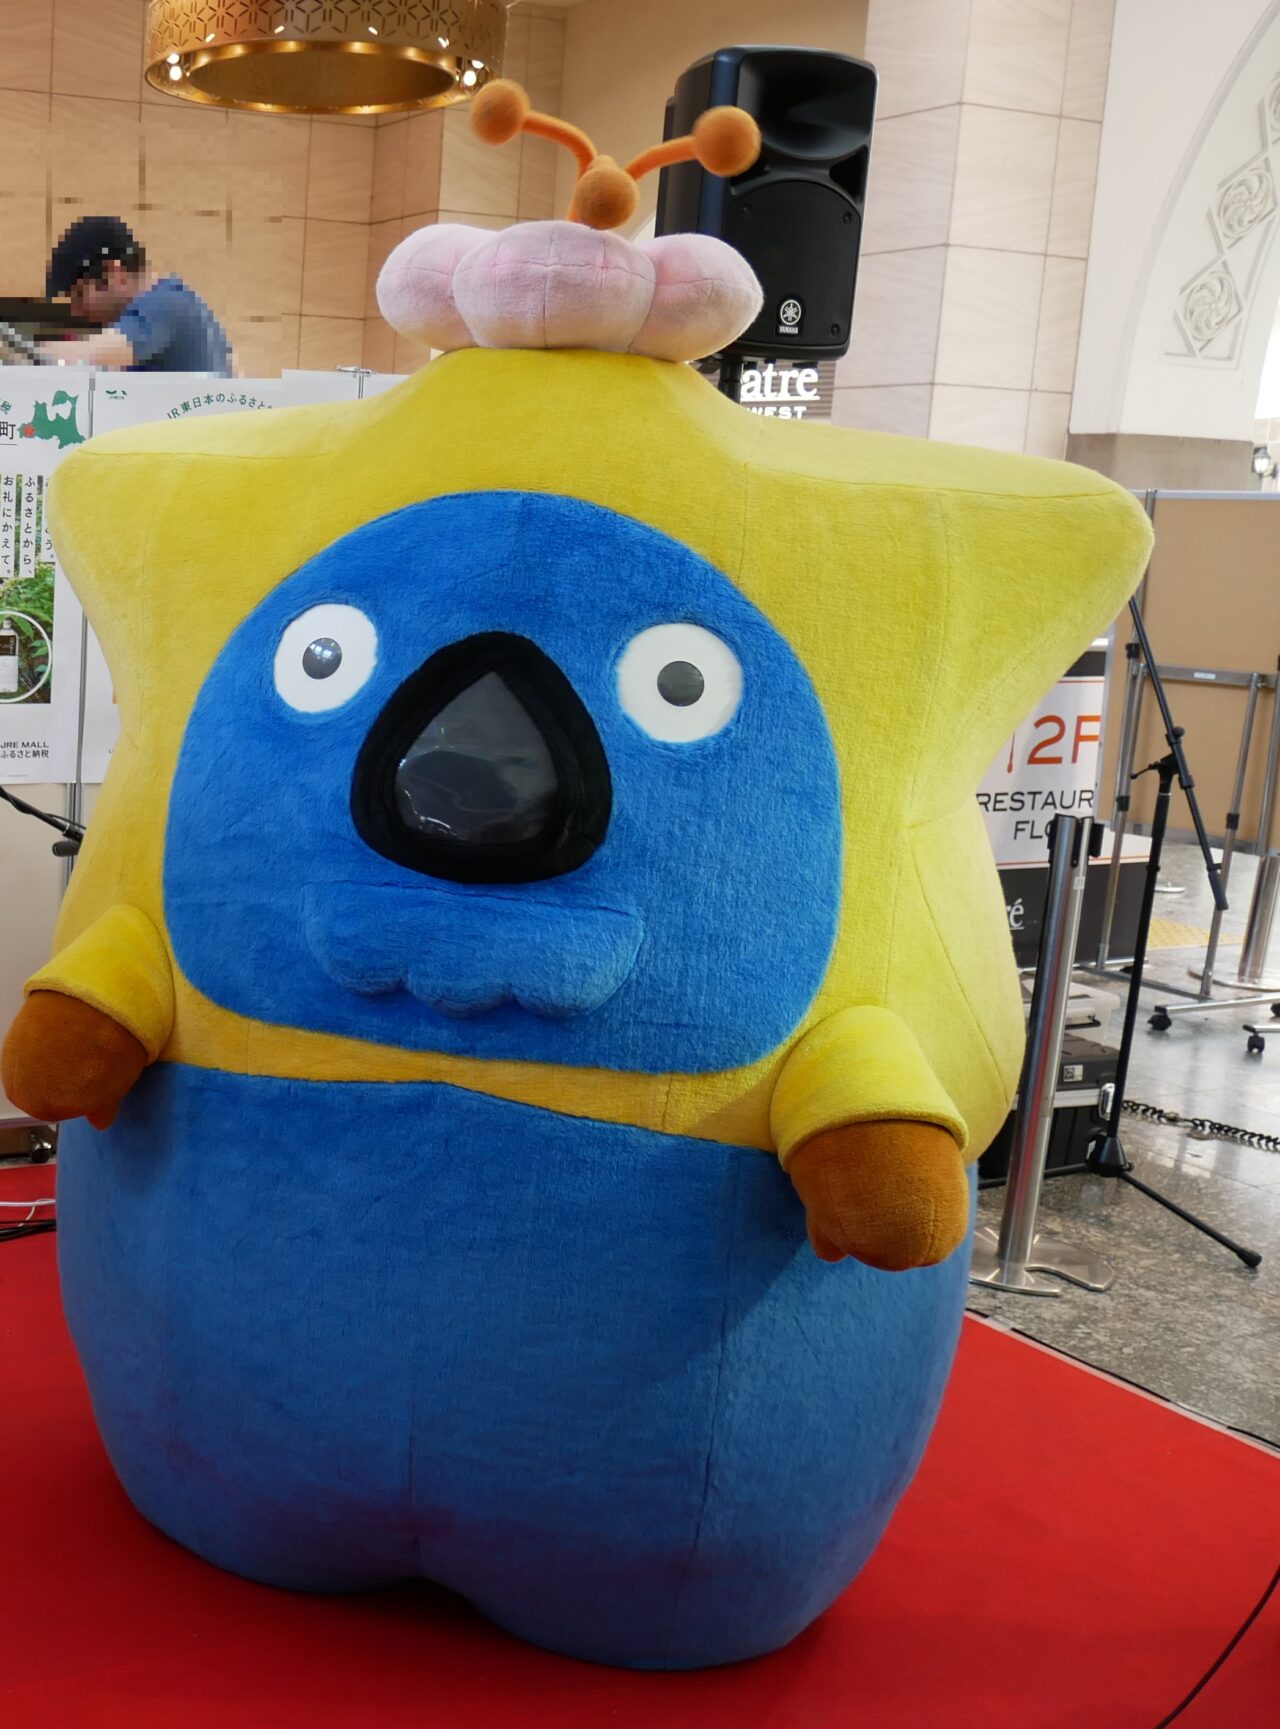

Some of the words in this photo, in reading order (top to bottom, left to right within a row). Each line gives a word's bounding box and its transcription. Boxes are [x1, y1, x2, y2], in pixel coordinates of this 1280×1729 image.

[779, 326, 798, 334] YAMAHA
[1, 476, 14, 574] お礼にかえて。
[23, 477, 35, 573] ふるさとから、
[1, 750, 49, 759] ふるさと納税
[1027, 715, 1101, 765] 2F
